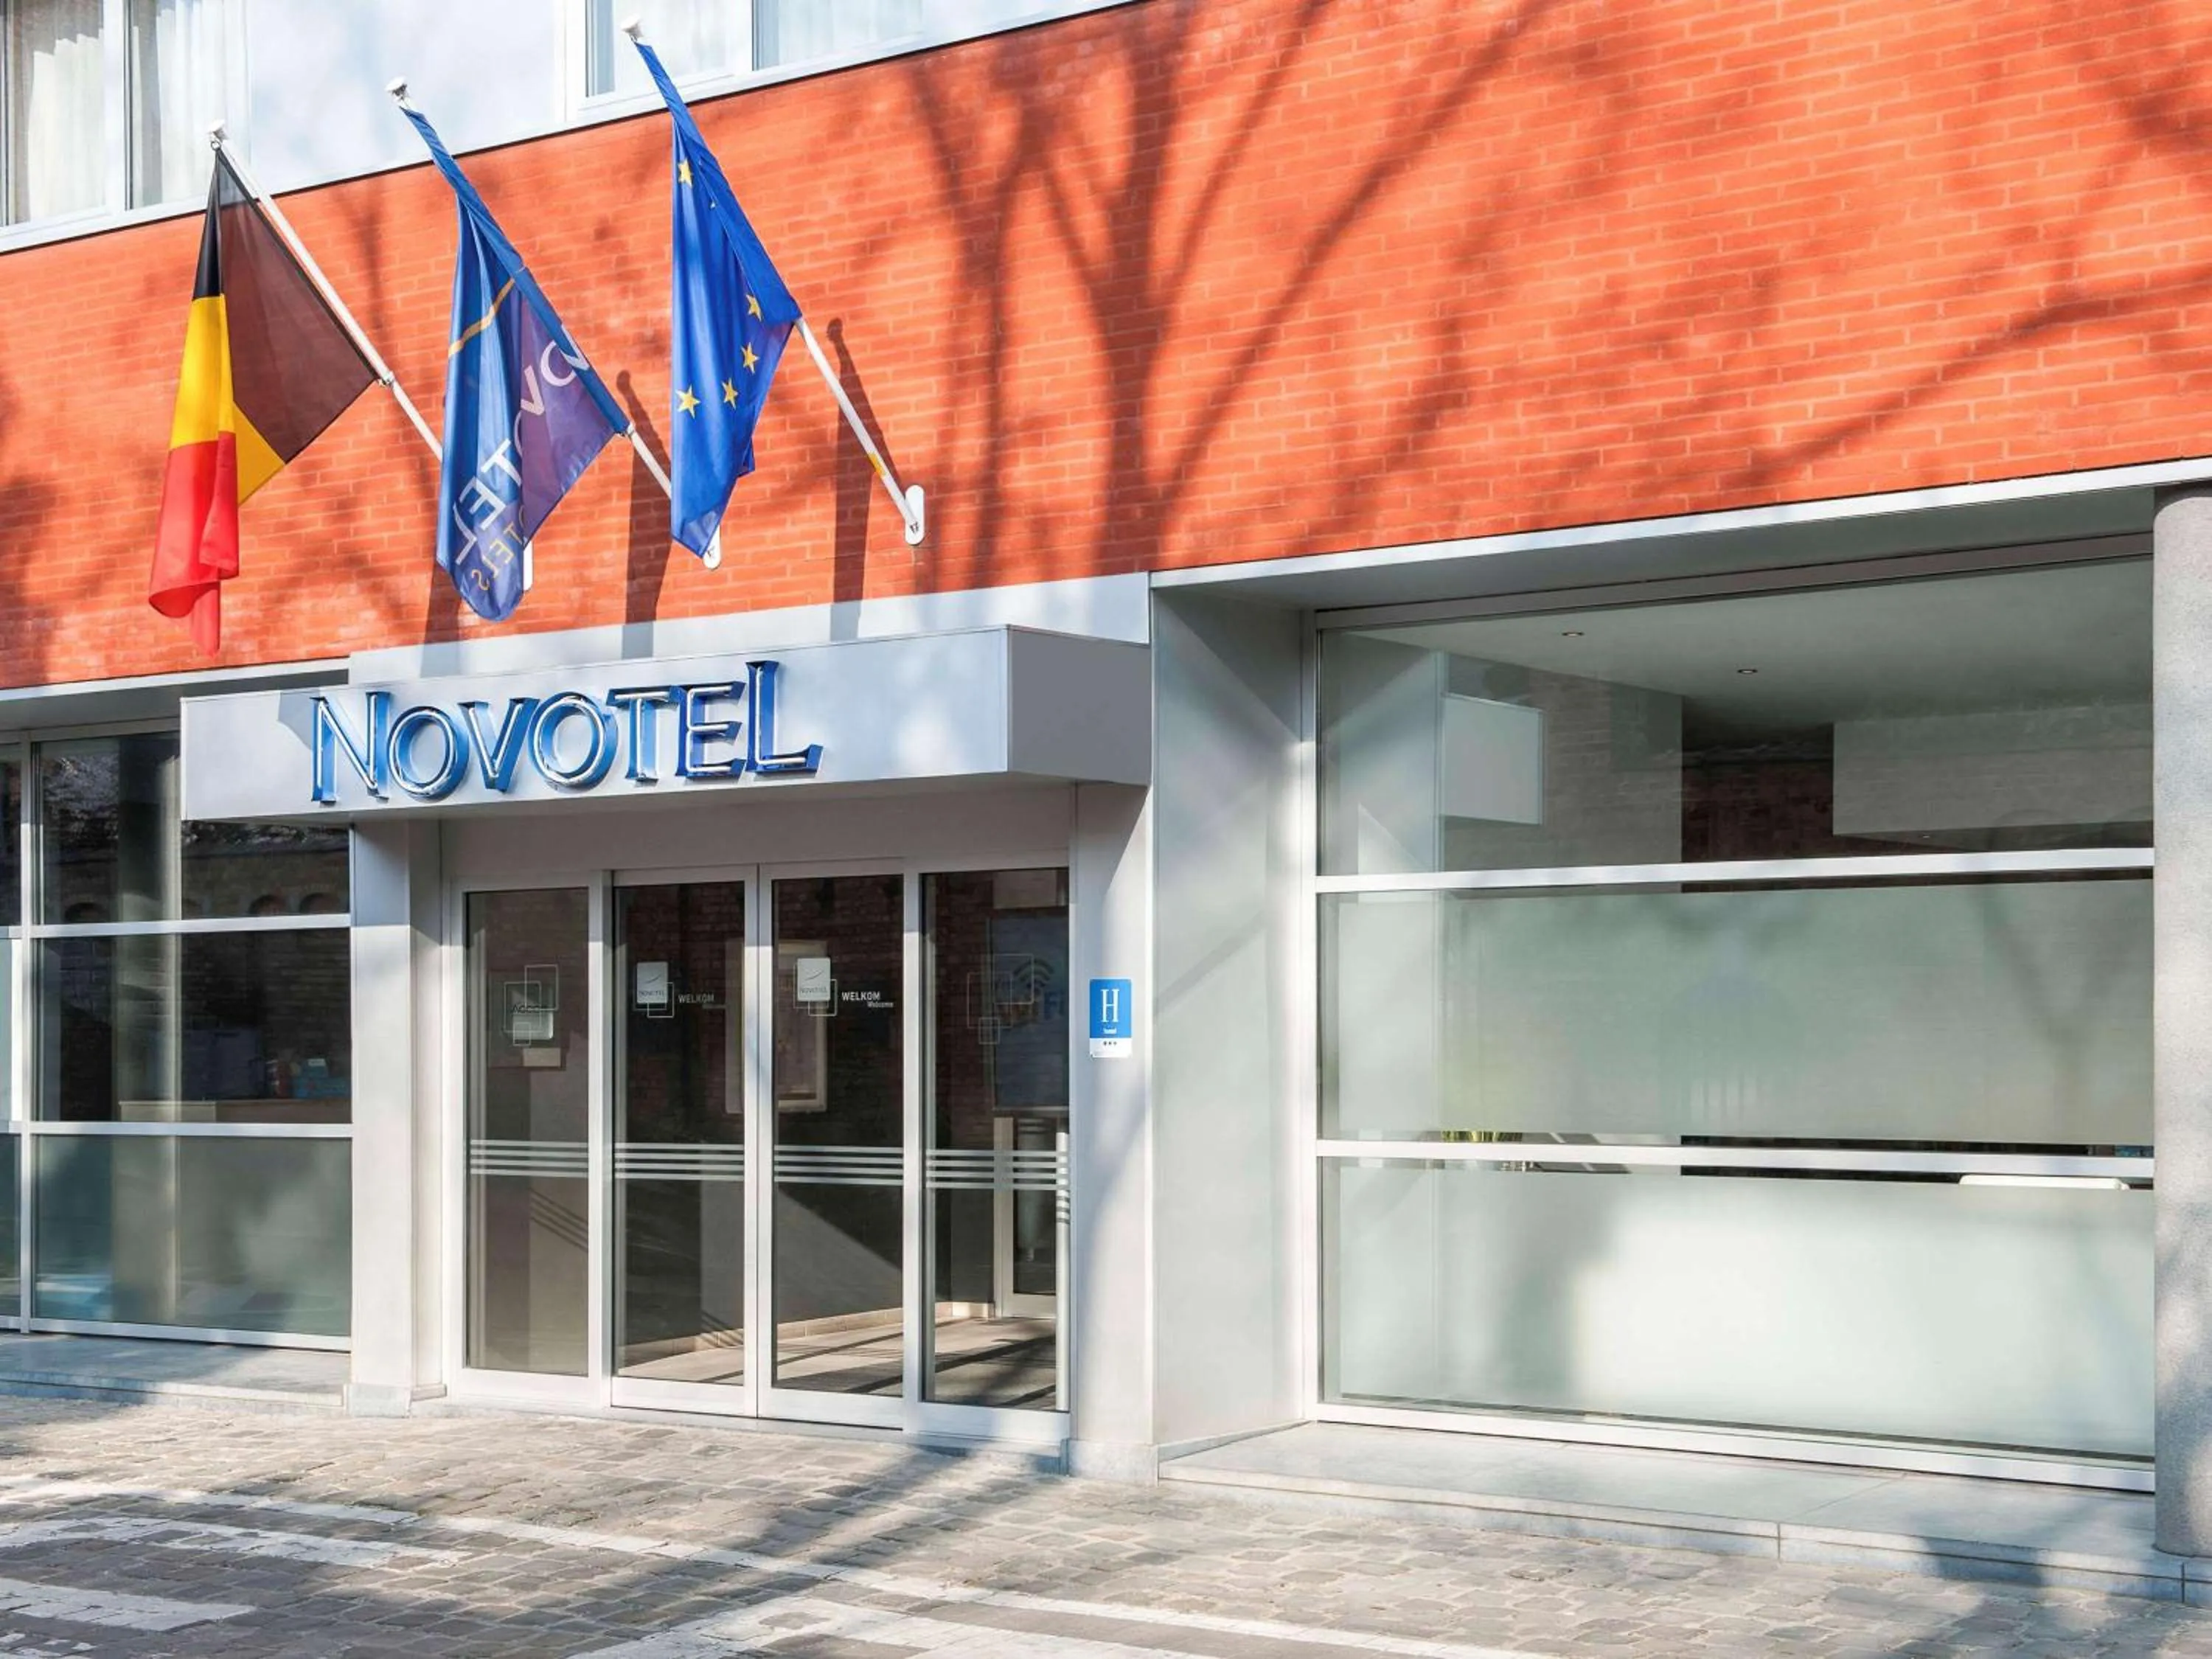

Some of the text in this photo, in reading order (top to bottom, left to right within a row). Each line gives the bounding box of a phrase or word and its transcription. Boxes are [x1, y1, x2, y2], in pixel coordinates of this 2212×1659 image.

[310, 661, 823, 802] NOVOTEL
[678, 993, 715, 1004] WELKOM
[841, 991, 881, 1001] WELKOM
[1100, 988, 1120, 1023] H
